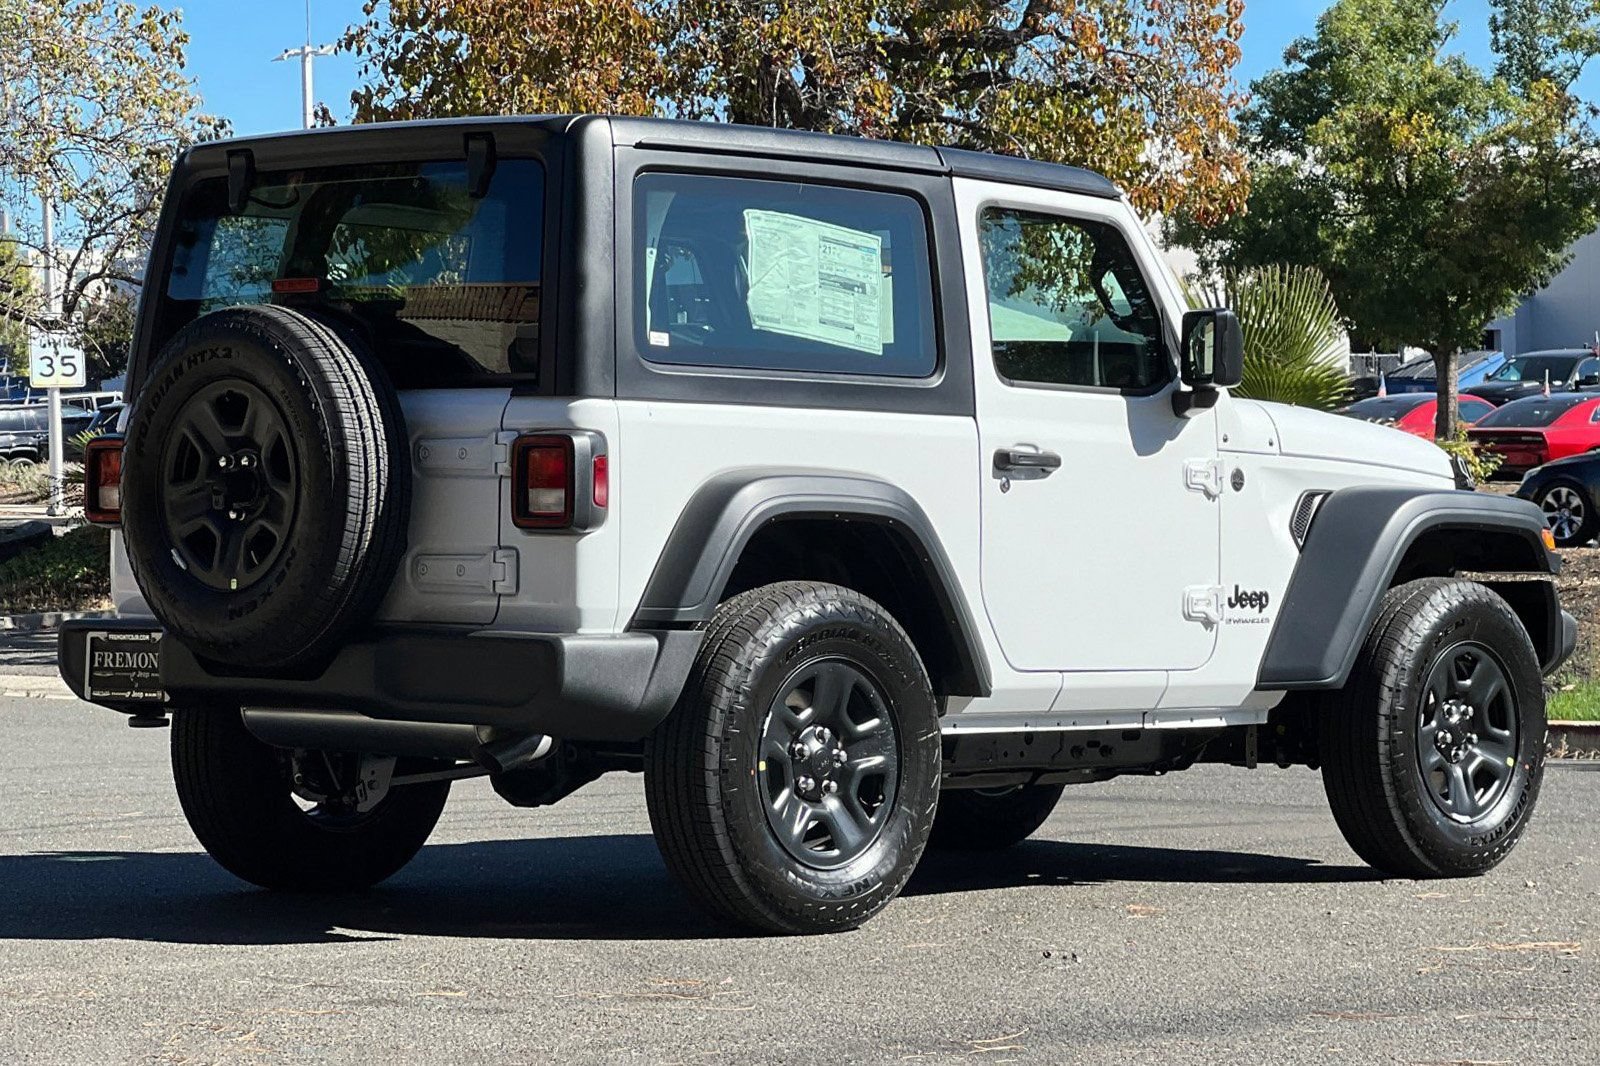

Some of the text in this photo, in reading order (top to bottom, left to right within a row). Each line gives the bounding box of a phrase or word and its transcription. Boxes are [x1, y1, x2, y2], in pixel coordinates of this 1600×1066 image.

[40, 356, 77, 377] 35
[1228, 584, 1269, 614] Jeep
[93, 651, 159, 669] FREMON
